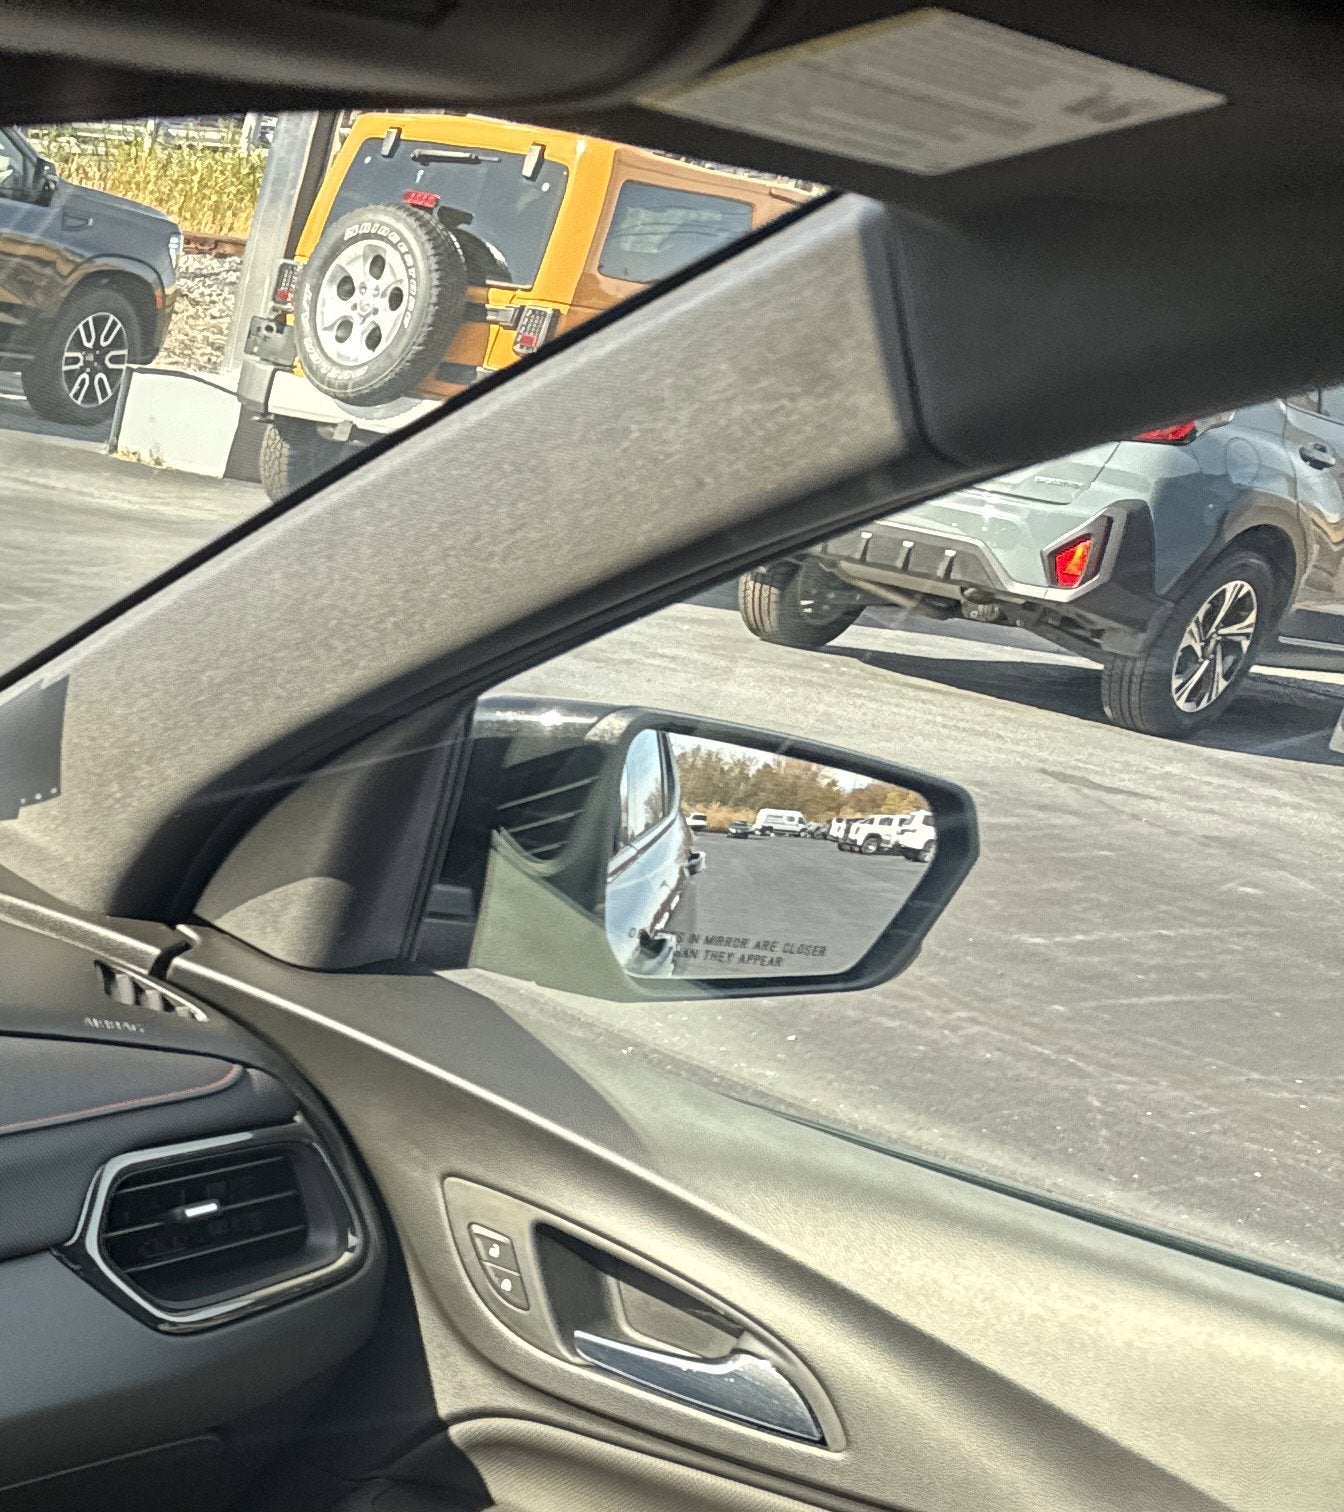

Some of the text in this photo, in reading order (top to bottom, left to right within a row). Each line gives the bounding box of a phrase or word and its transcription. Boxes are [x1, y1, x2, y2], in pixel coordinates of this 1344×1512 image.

[705, 935, 748, 949] MIRROR
[755, 940, 778, 952] ARE
[783, 942, 827, 957] CLOSER
[703, 950, 734, 963] THEY
[738, 954, 784, 967] APPEAR
